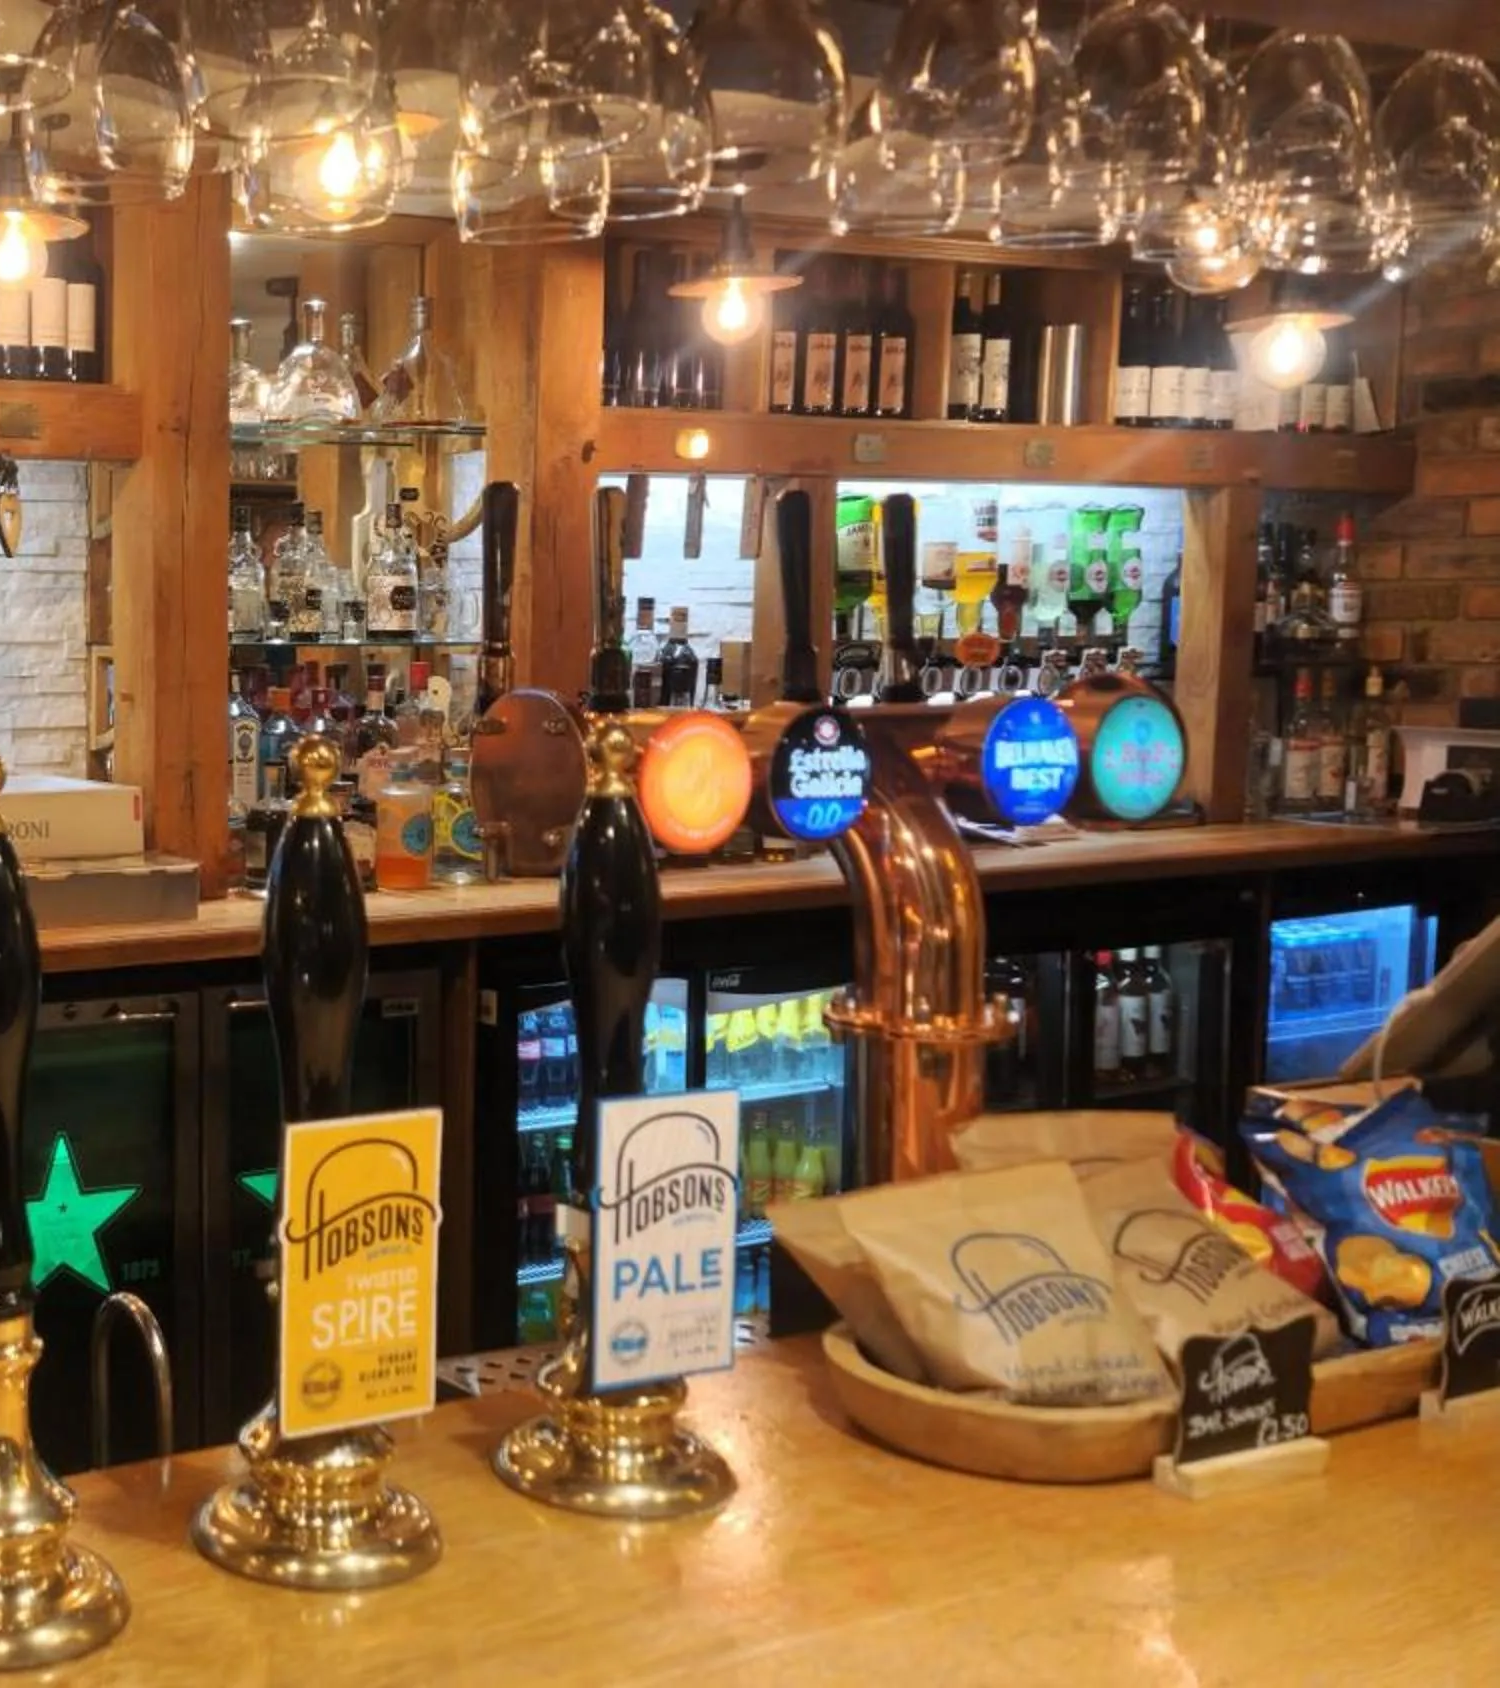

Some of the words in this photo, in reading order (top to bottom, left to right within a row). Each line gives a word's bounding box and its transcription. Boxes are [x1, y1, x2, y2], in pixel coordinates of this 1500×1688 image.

[1011, 767, 1065, 791] BEST
[303, 1190, 424, 1281] HOBSONS
[612, 1160, 725, 1246] HOBSONS
[612, 1248, 723, 1302] PALE
[971, 1269, 1108, 1346] HOBSONS
[311, 1288, 420, 1350] SPIRE
